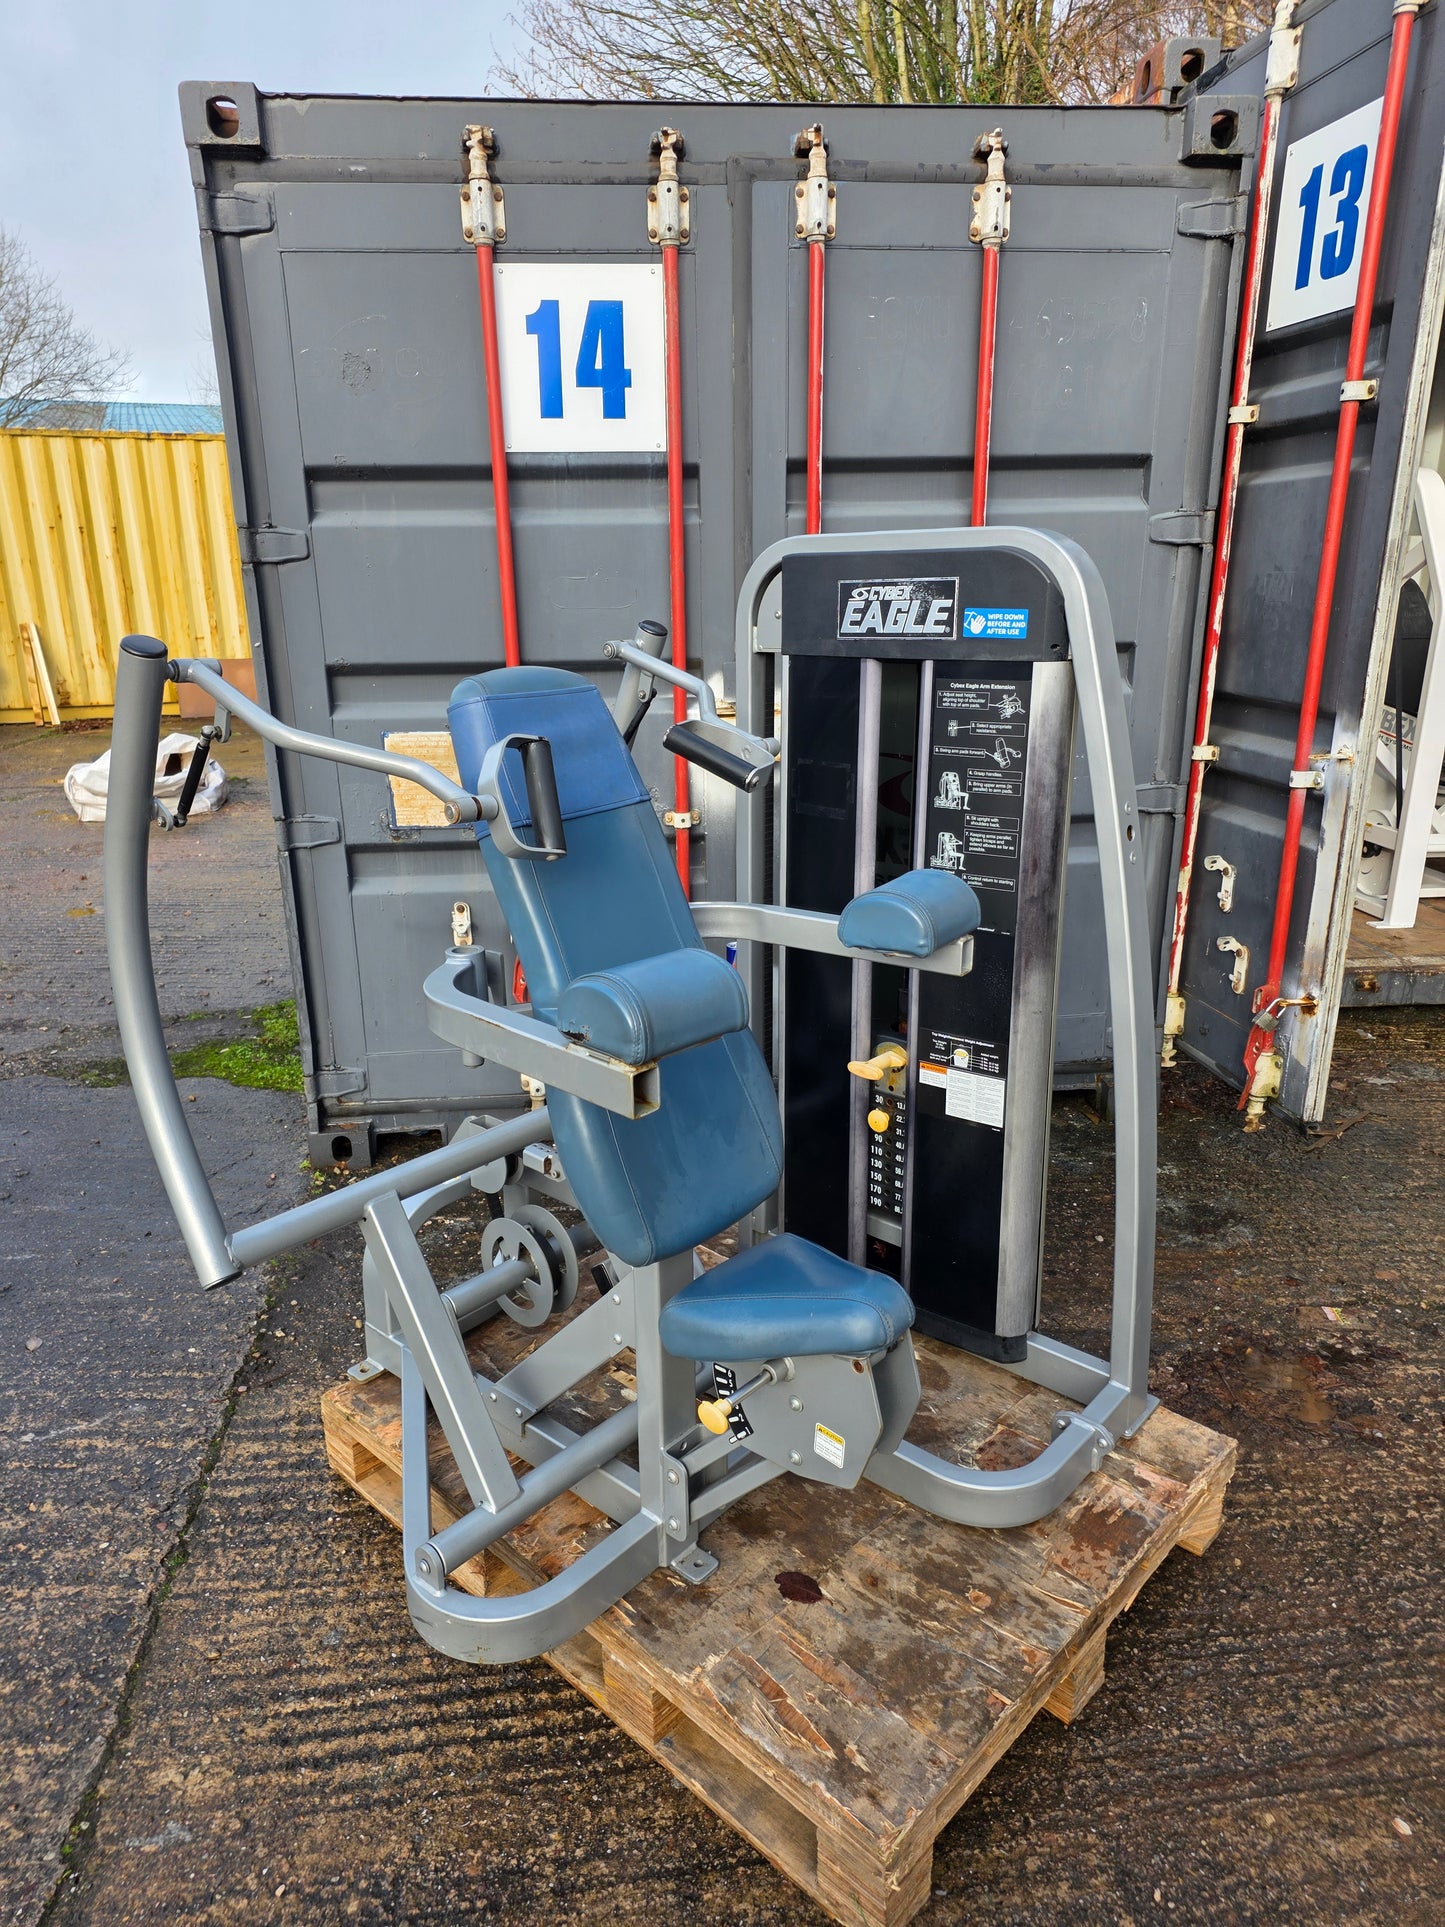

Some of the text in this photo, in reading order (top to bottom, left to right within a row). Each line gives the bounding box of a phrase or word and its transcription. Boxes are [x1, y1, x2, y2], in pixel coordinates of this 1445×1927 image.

[1295, 144, 1368, 291] 13
[526, 300, 632, 419] 14
[868, 586, 913, 600] CYBEX
[1385, 737, 1412, 752] SYSEMS
[875, 1095, 884, 1104] 30
[896, 1115, 905, 1123] 22.
[896, 1128, 905, 1136] 31.
[874, 1134, 883, 1143] 90
[871, 1145, 882, 1156] 110
[871, 1158, 882, 1168] 130
[870, 1171, 882, 1182] 150
[870, 1184, 881, 1194] 170
[870, 1196, 881, 1207] 190
[727, 1370, 732, 1378] 6
[739, 1413, 744, 1422] 2
[745, 1427, 751, 1435] 1
